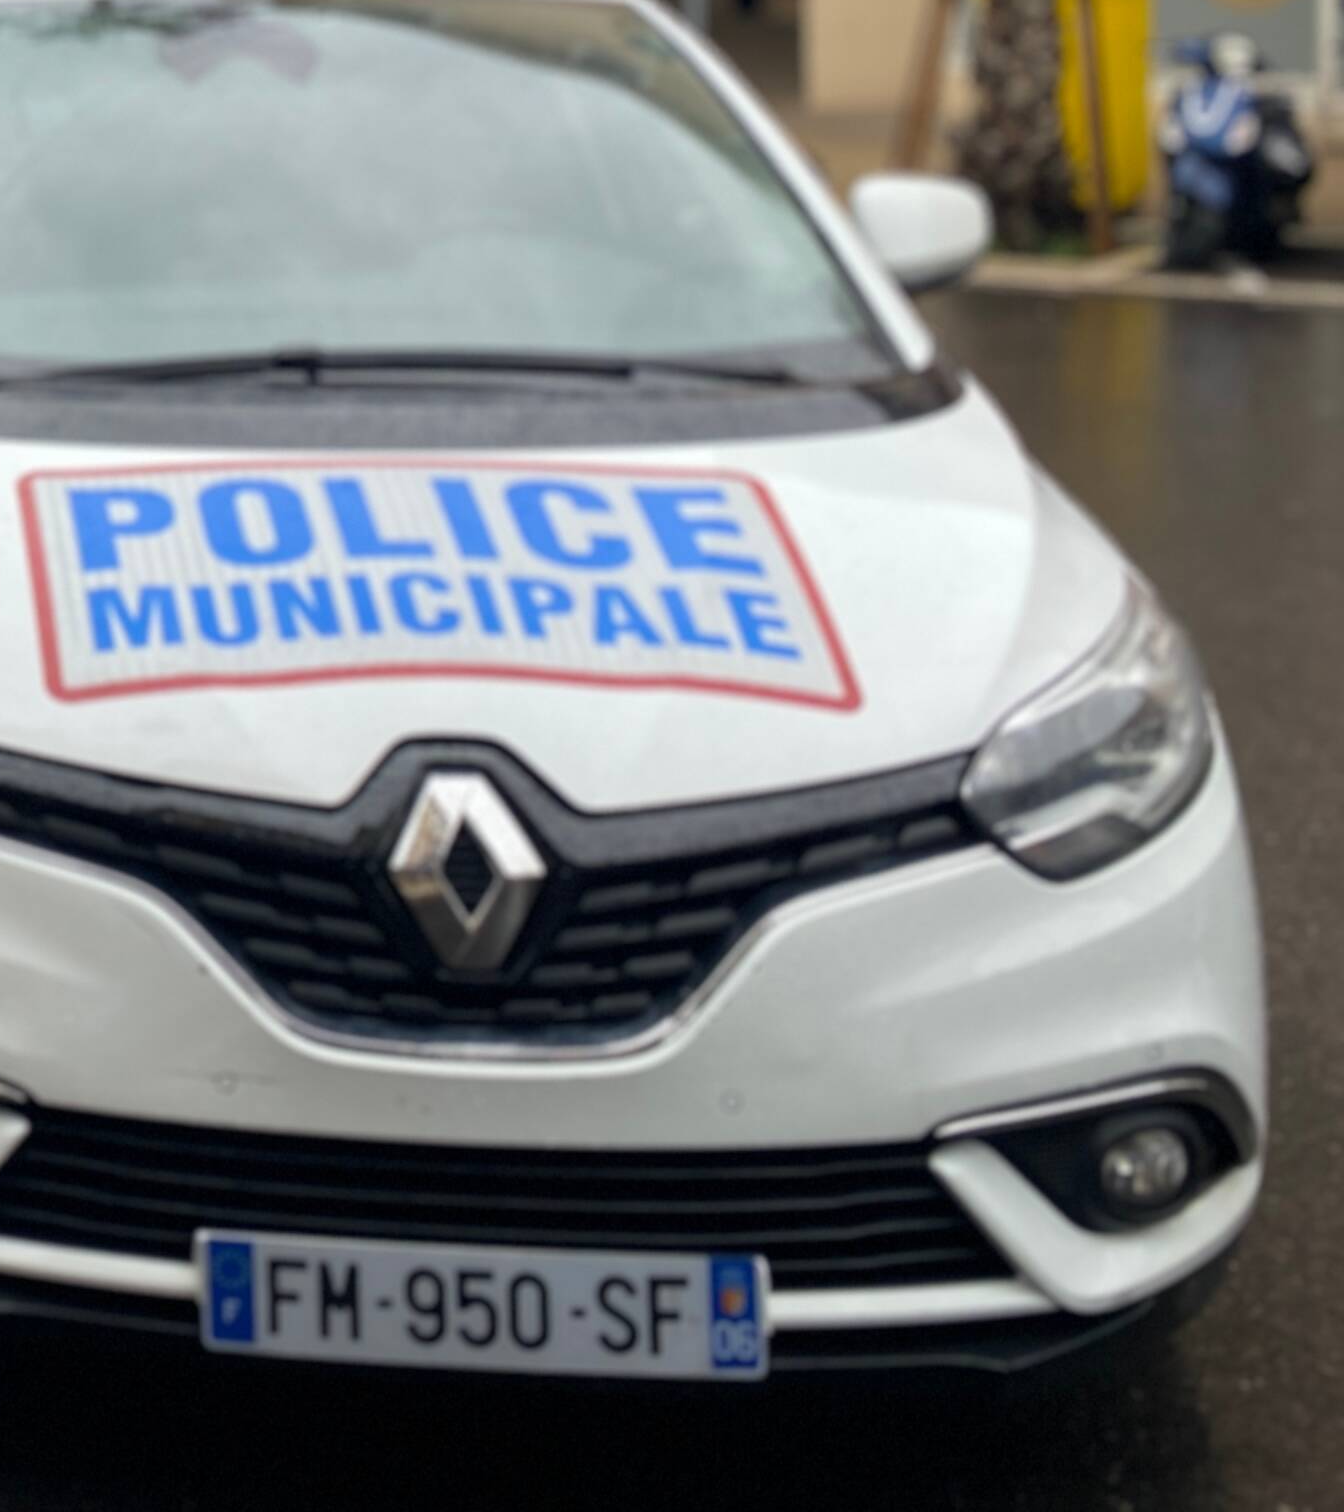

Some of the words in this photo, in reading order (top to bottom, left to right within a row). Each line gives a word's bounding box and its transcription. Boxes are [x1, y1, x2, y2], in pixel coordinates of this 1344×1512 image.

[67, 475, 767, 578] POLICE
[87, 572, 803, 662] MUNICIPALE
[221, 1298, 242, 1326] F
[266, 1258, 689, 1356] FM-950-SF
[713, 1321, 758, 1361] 06
